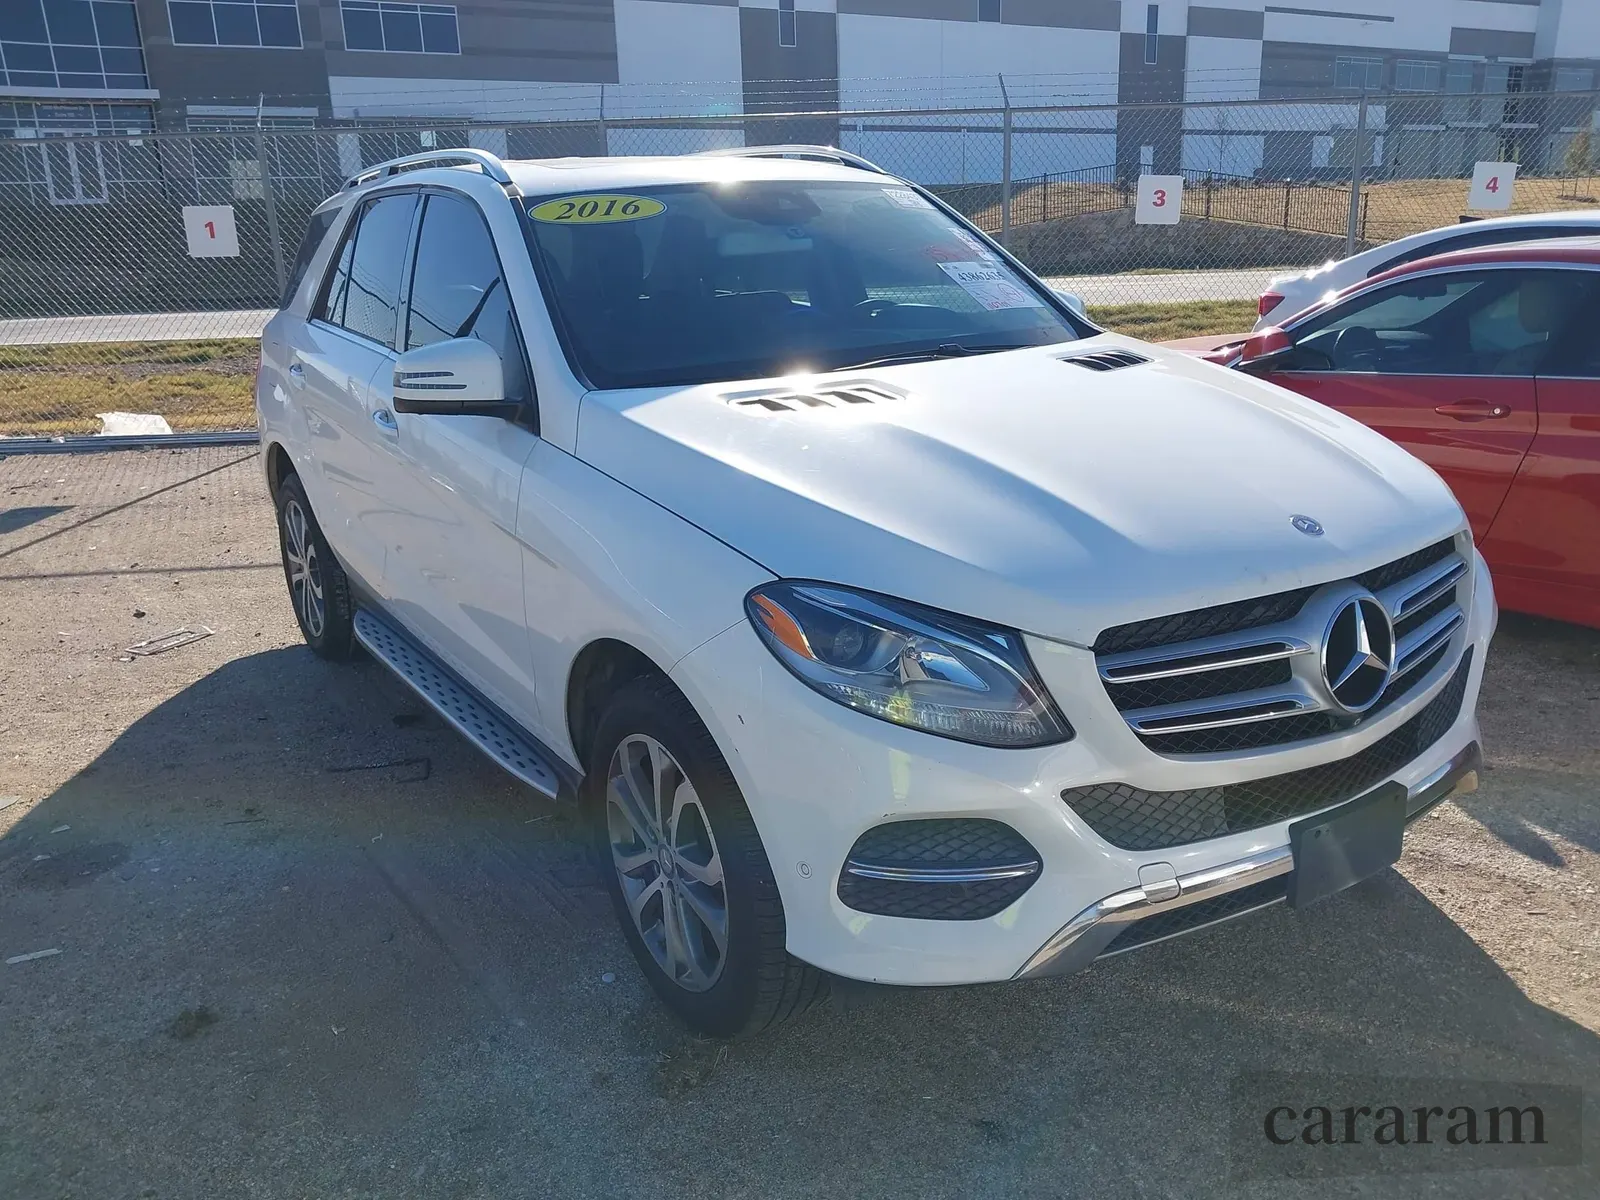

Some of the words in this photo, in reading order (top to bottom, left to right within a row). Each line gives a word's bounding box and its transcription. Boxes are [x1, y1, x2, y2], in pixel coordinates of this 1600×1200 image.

[1485, 176, 1499, 193] 4
[1152, 189, 1166, 207] 3
[553, 199, 641, 221] 2016
[204, 221, 216, 239] 1
